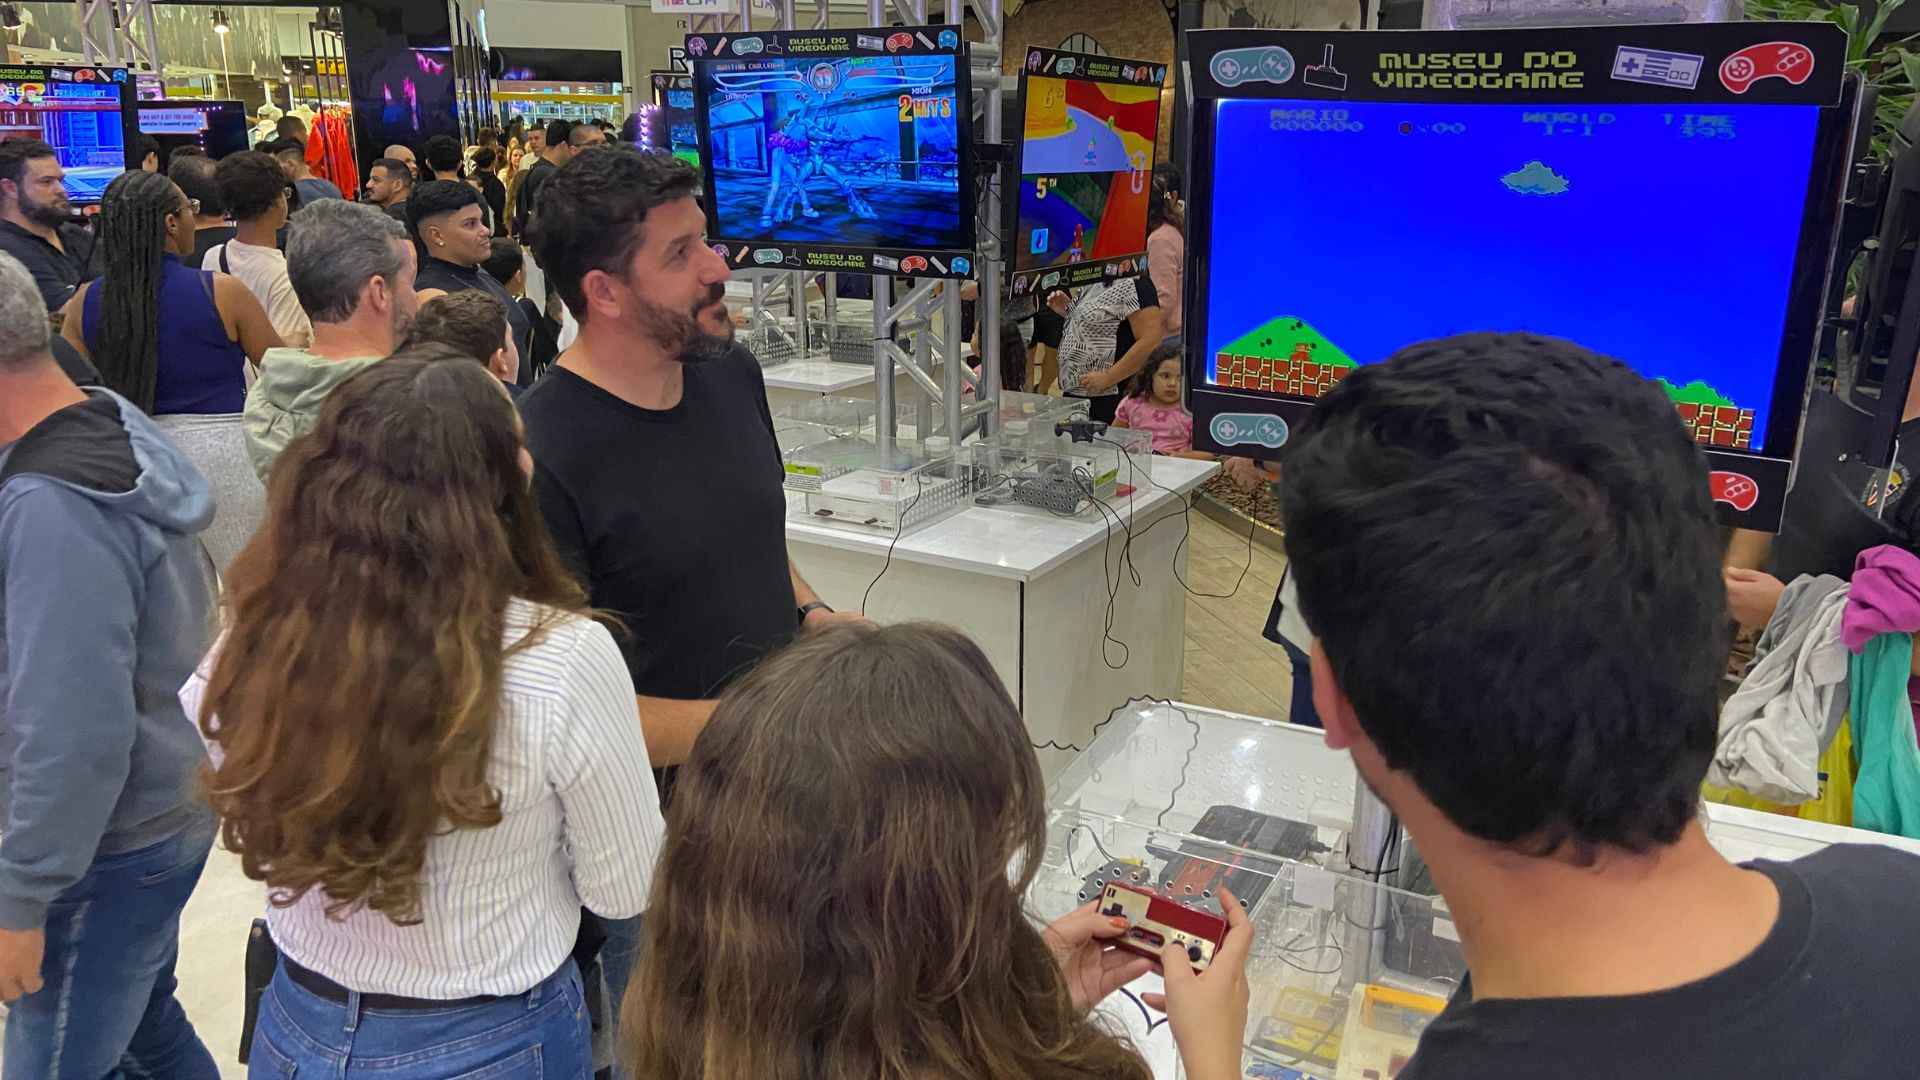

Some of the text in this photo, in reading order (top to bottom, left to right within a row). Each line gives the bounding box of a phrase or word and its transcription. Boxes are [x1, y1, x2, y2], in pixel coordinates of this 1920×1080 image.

[789, 37, 825, 45] MUSEU
[1379, 51, 1576, 69] MUSEU DO
[1372, 71, 1584, 89] VIDEOGAME
[898, 94, 951, 122] 2 HITS
[1269, 108, 1349, 121] MARIO
[1522, 111, 1617, 125] WORLD
[1660, 113, 1737, 127] TIME
[1269, 120, 1364, 132] 000000
[1542, 124, 1596, 137] 1-1
[807, 252, 844, 260] MUSEU
[806, 258, 866, 268] VIDEOGAME
